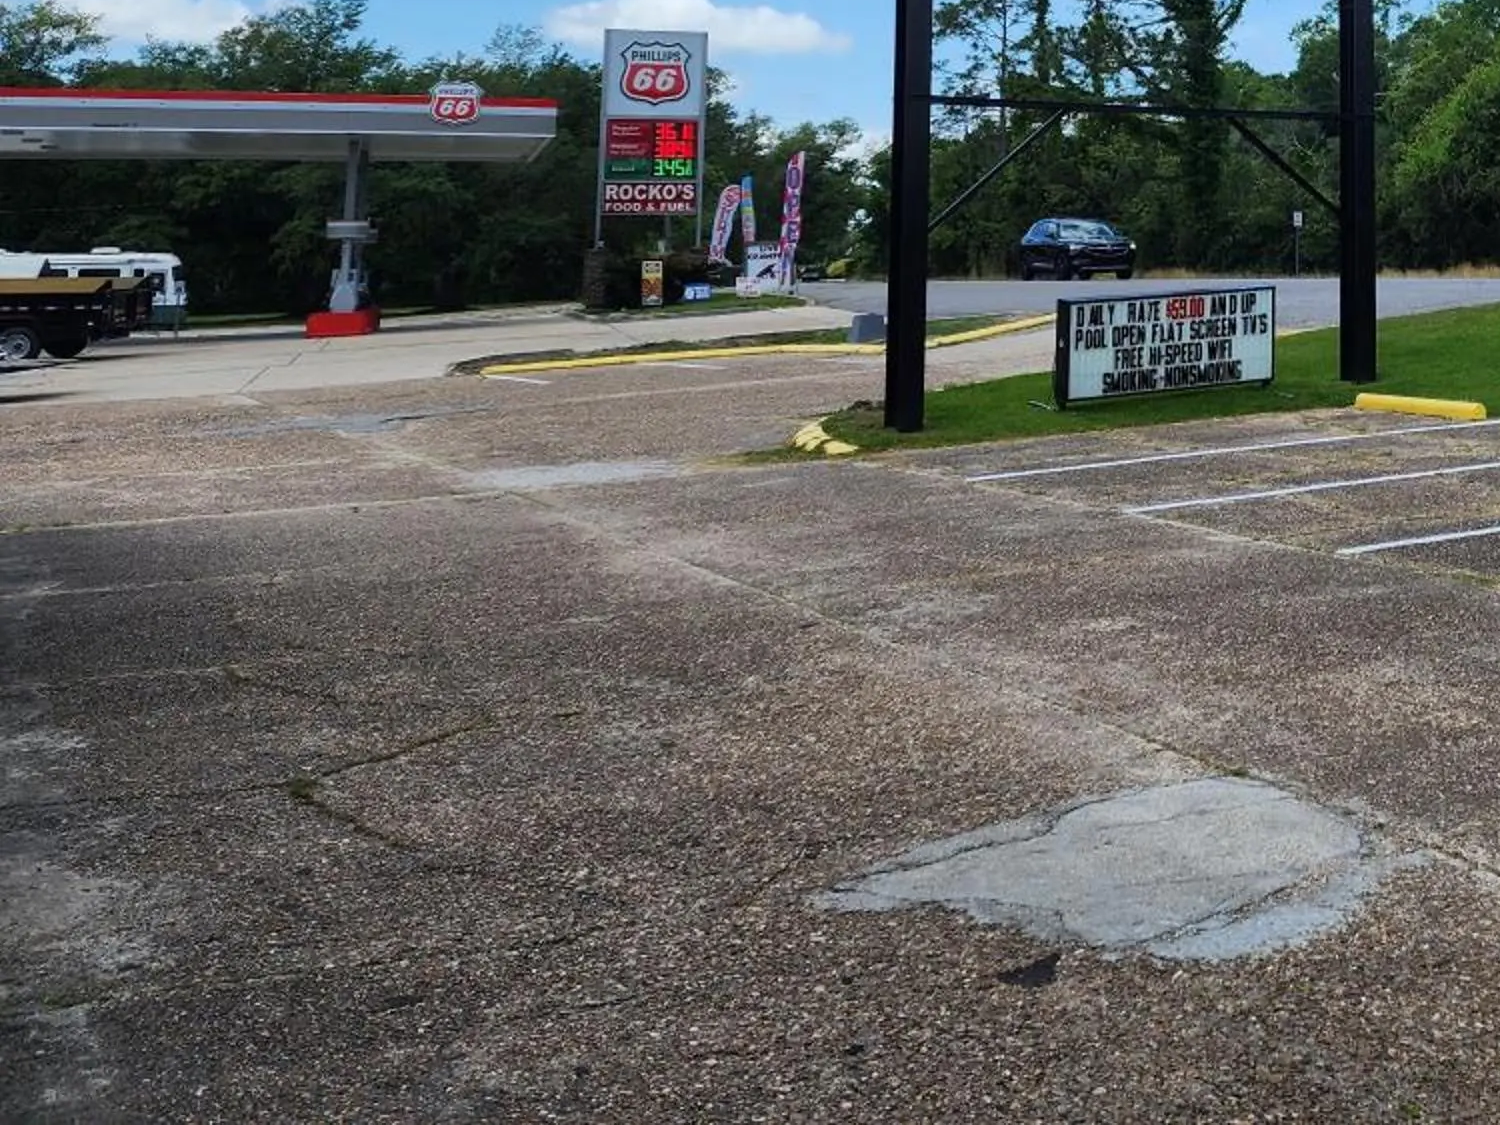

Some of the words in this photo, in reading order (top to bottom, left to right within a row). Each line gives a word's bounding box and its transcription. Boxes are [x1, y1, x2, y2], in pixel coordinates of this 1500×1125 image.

[631, 50, 681, 62] PHILLIPS
[633, 67, 677, 92] 66
[440, 99, 471, 116] 66
[605, 184, 695, 201] ROCKO'S
[605, 202, 642, 212] FOOD
[660, 202, 692, 212] FUEL
[1076, 303, 1115, 328] DAILY
[1127, 300, 1160, 324] RATE
[1209, 294, 1236, 316] AND
[1241, 292, 1257, 314] UP
[1075, 328, 1108, 352] POOL
[1112, 324, 1146, 348] OPEN
[1151, 321, 1184, 344] FLAT
[1189, 316, 1237, 341] SCREEN
[1114, 346, 1144, 370] FREE
[1149, 342, 1203, 366] HI-SPEED
